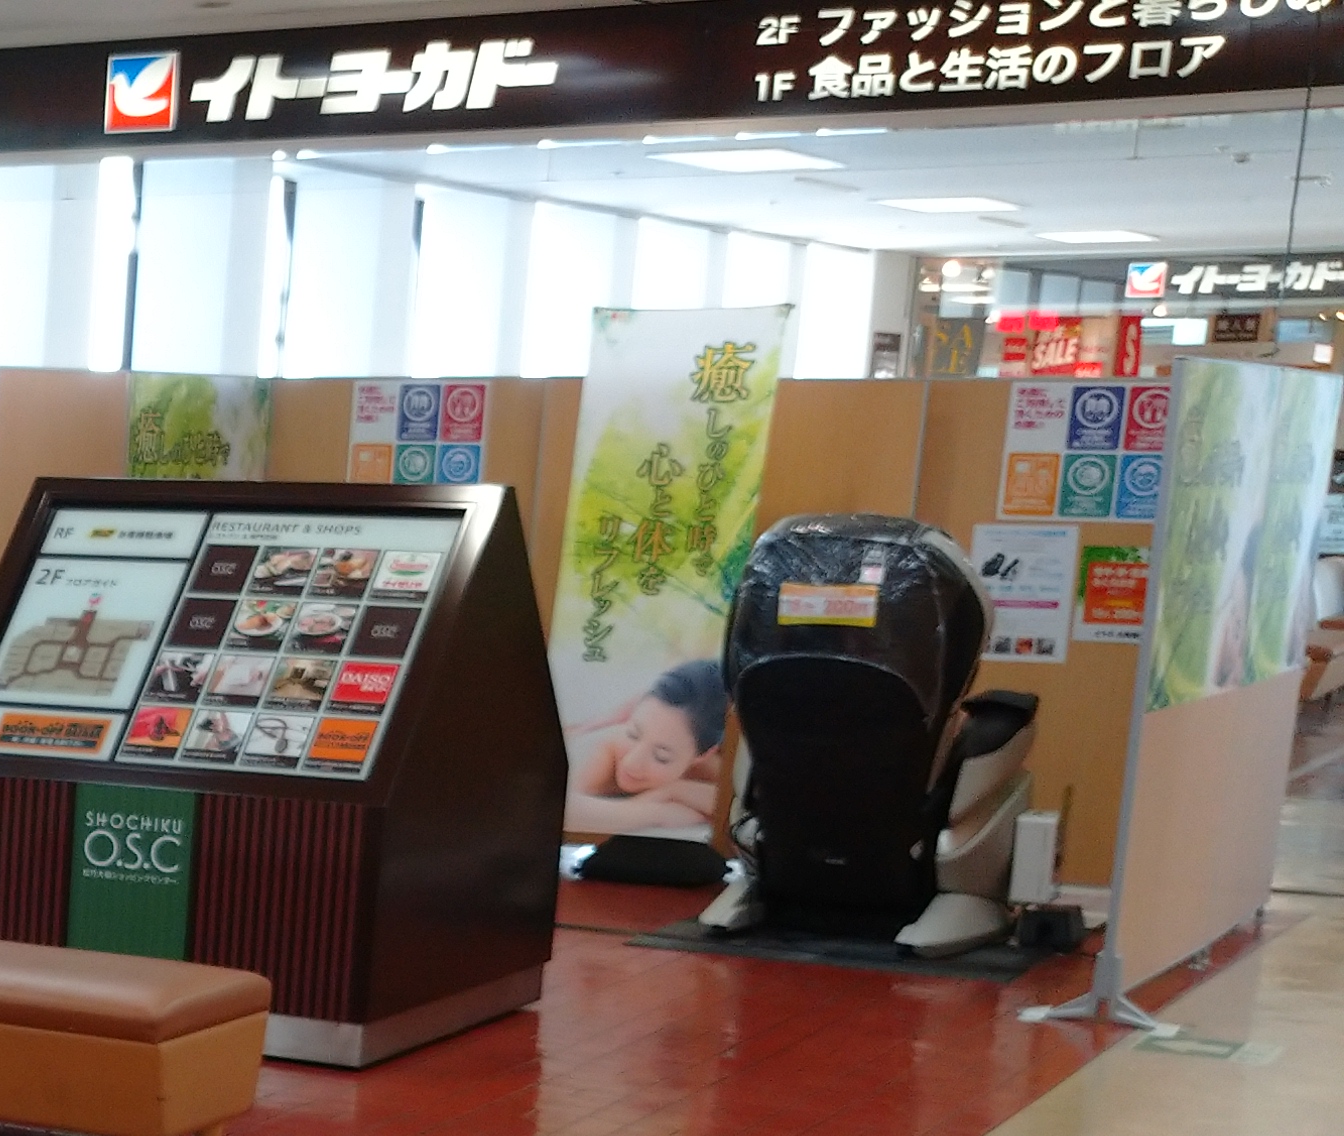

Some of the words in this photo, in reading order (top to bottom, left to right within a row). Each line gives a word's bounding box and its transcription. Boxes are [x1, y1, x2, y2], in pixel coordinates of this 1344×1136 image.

[756, 17, 802, 46] 2F
[817, 0, 1333, 46] ファッションと暮ら
[189, 37, 560, 123] イトーヨーカドー
[754, 71, 797, 102] 1F
[807, 34, 1226, 101] 食品と生活のフロア
[1031, 335, 1079, 370] SALE
[686, 341, 759, 578] 癒しのひと時を
[212, 521, 300, 534] RESTAURANT
[315, 524, 362, 536] SHOPS
[631, 442, 686, 597] 心と体を
[35, 569, 66, 586] 2F
[582, 514, 625, 664] リフレッシュ
[341, 672, 391, 685] DAISO
[85, 810, 183, 835] SHOCHIKU
[83, 828, 182, 874] O.S.C
